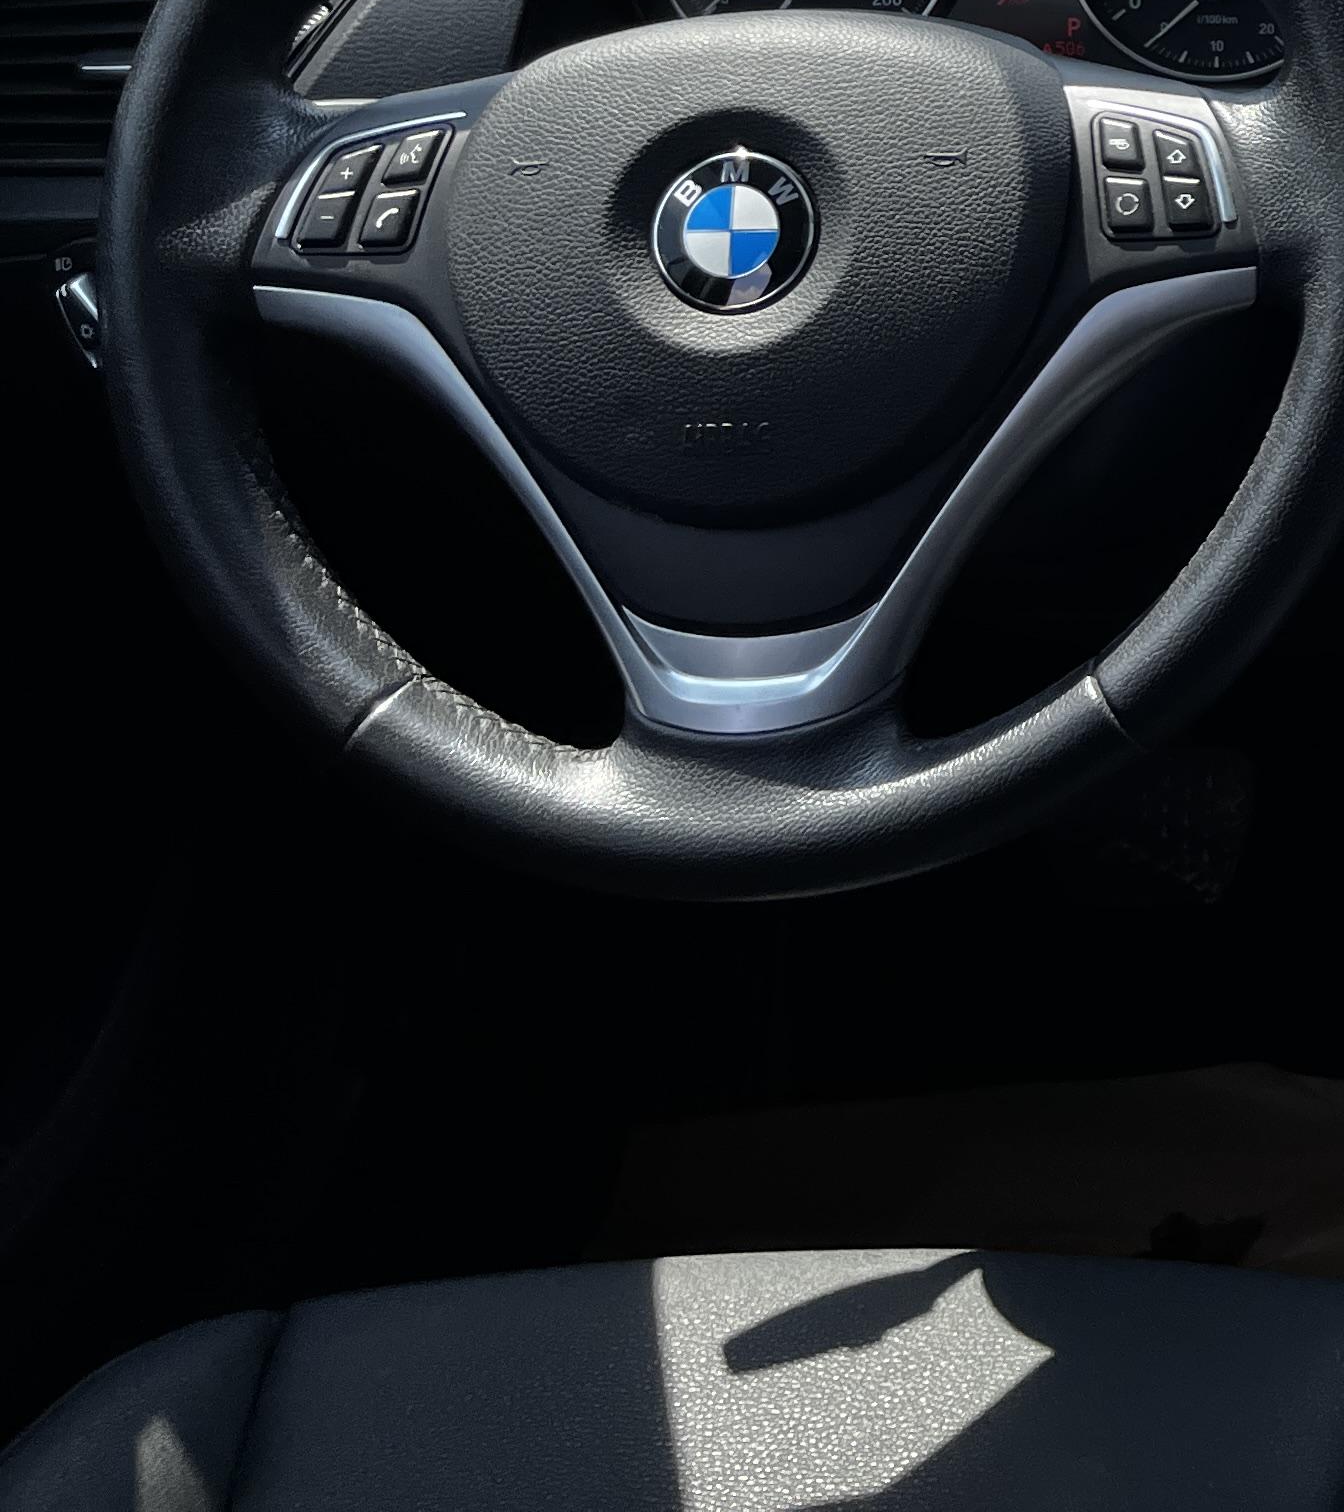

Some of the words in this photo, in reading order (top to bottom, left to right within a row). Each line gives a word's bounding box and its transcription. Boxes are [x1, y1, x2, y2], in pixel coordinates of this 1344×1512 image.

[1067, 17, 1081, 37] P
[1258, 23, 1275, 35] 20
[1210, 39, 1224, 52] 10
[674, 159, 799, 207] BMW
